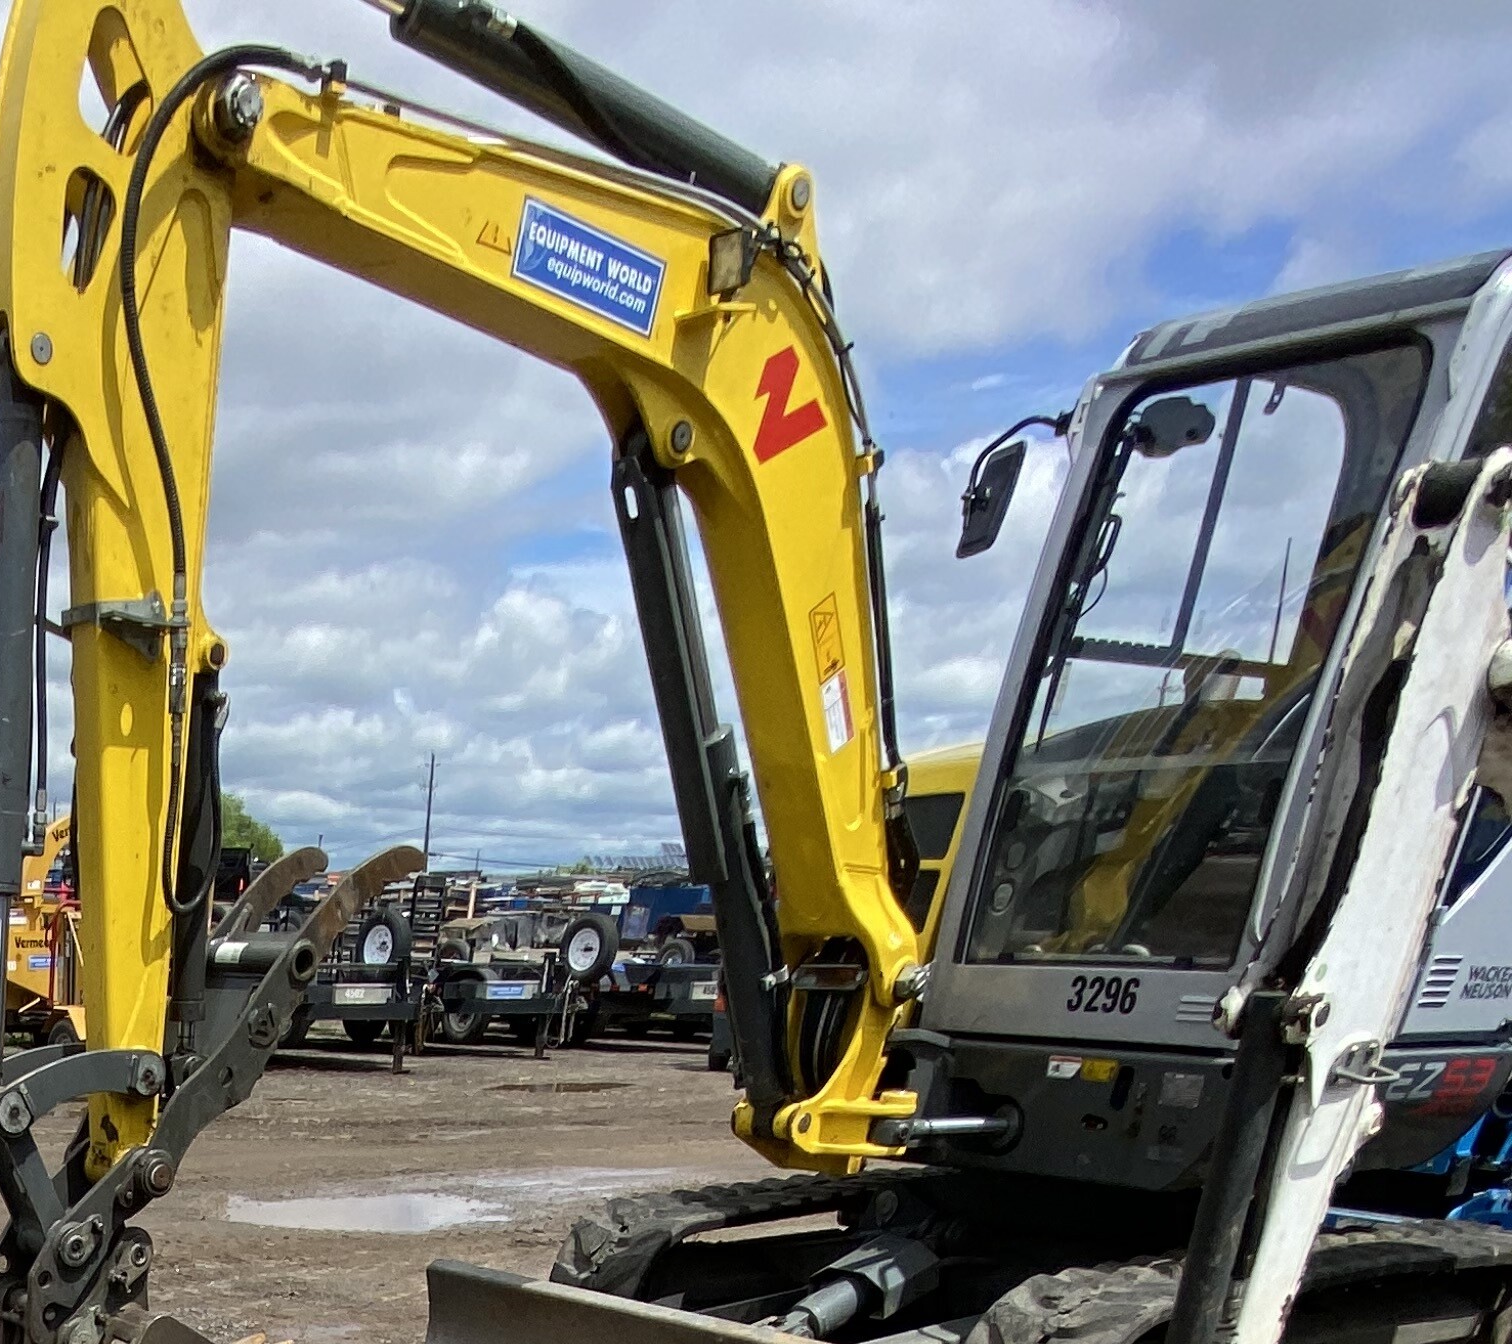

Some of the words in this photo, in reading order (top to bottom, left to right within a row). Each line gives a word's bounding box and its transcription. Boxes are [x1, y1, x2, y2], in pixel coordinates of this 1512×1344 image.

[528, 220, 605, 273] EQUIPMENT
[607, 256, 654, 296] WORLD
[546, 255, 648, 314] equipworld.com
[1067, 975, 1140, 1014] 3296
[1460, 982, 1512, 1000] NEUSON
[1385, 1058, 1497, 1101] EZ53
